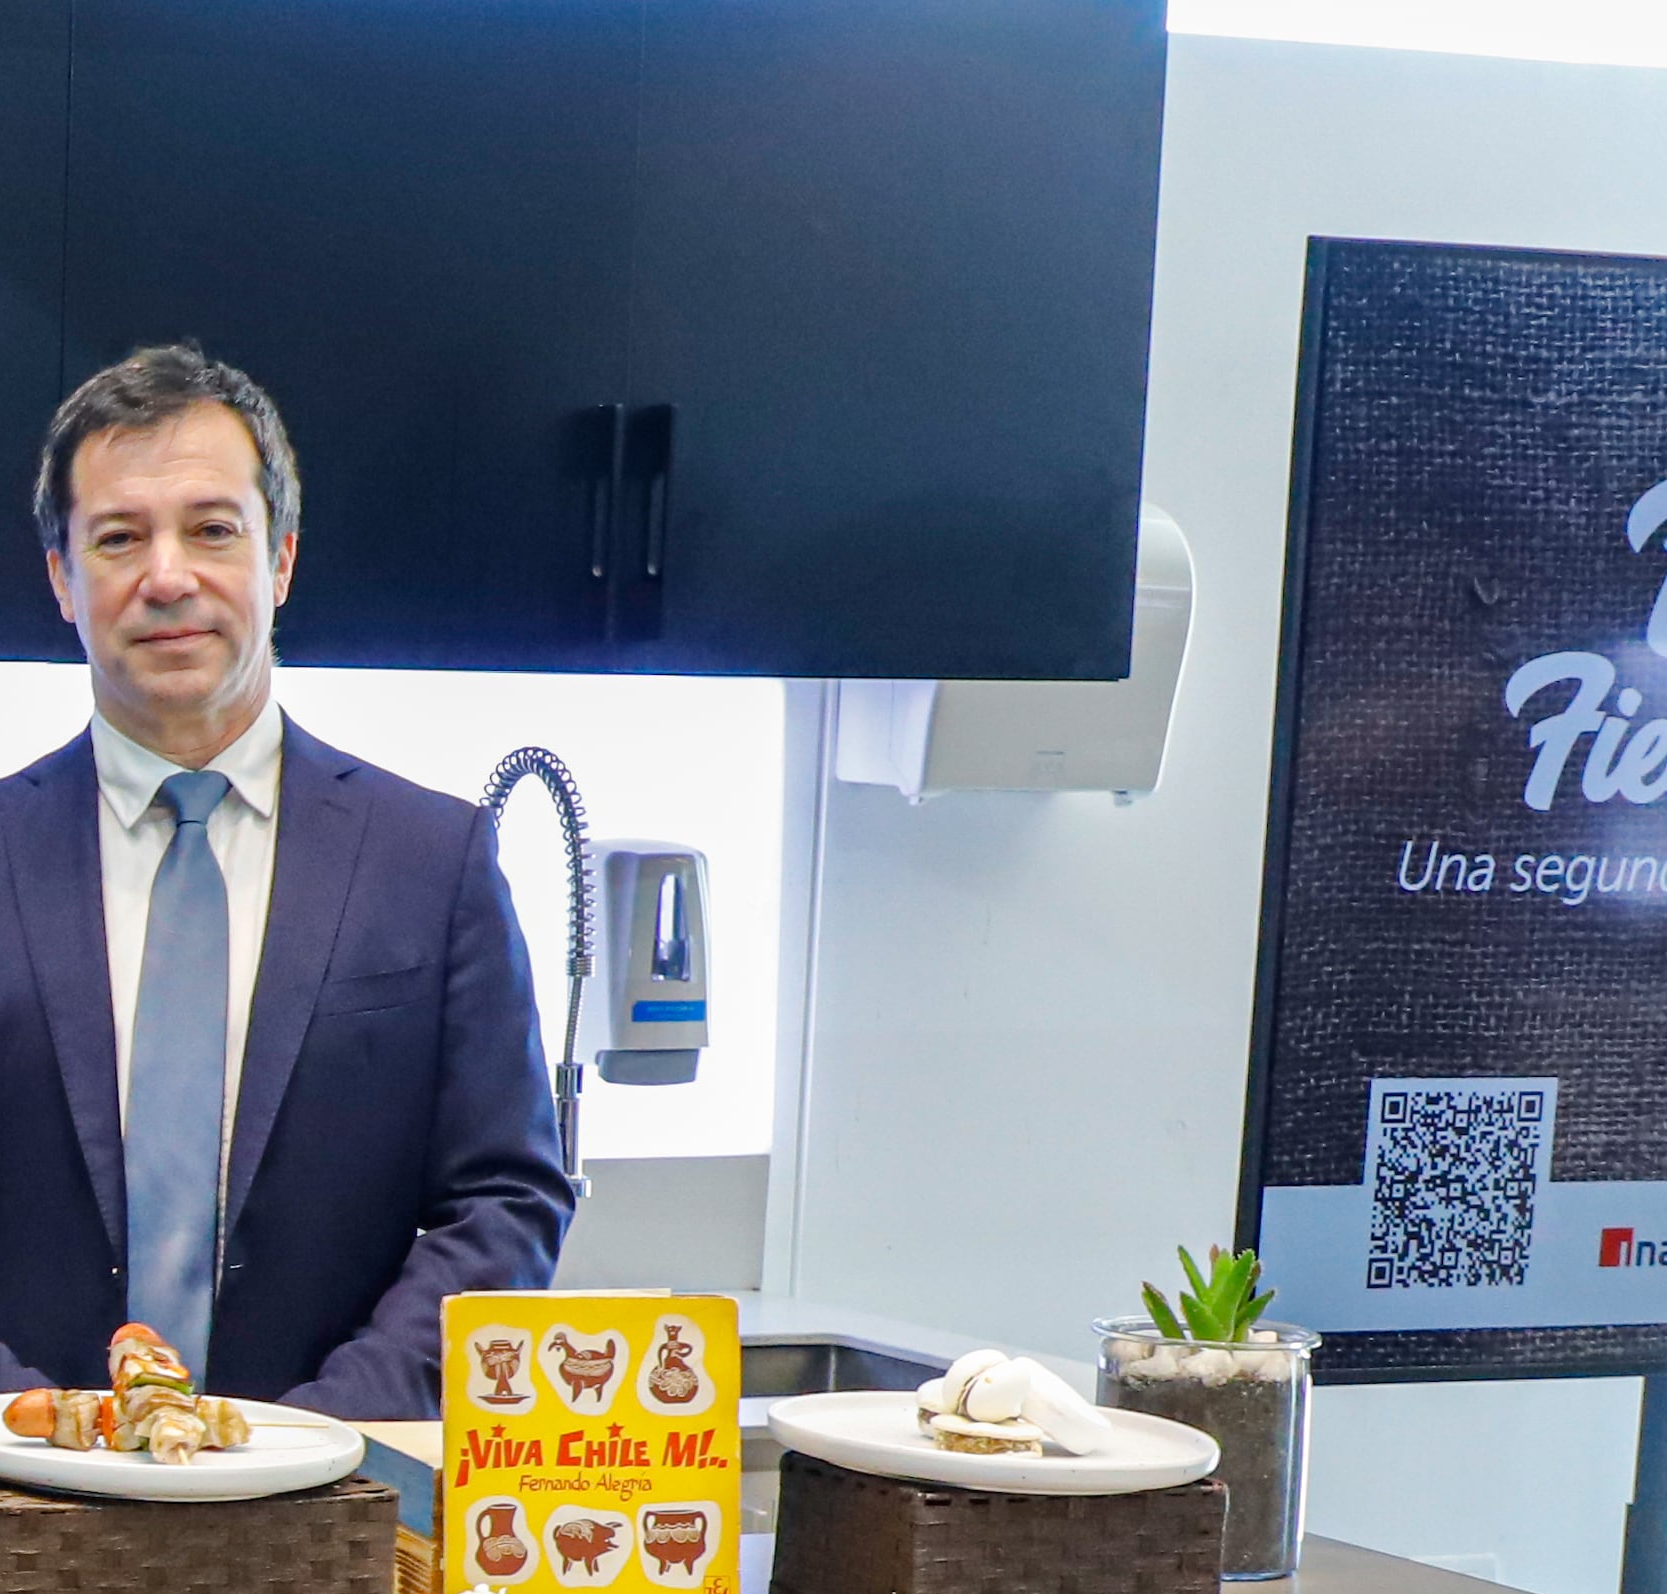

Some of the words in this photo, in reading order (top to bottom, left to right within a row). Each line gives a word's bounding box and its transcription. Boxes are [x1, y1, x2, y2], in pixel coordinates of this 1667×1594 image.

[1398, 840, 1496, 892] Una
[519, 1471, 591, 1493] Fernando
[596, 1472, 653, 1503] Alegría
